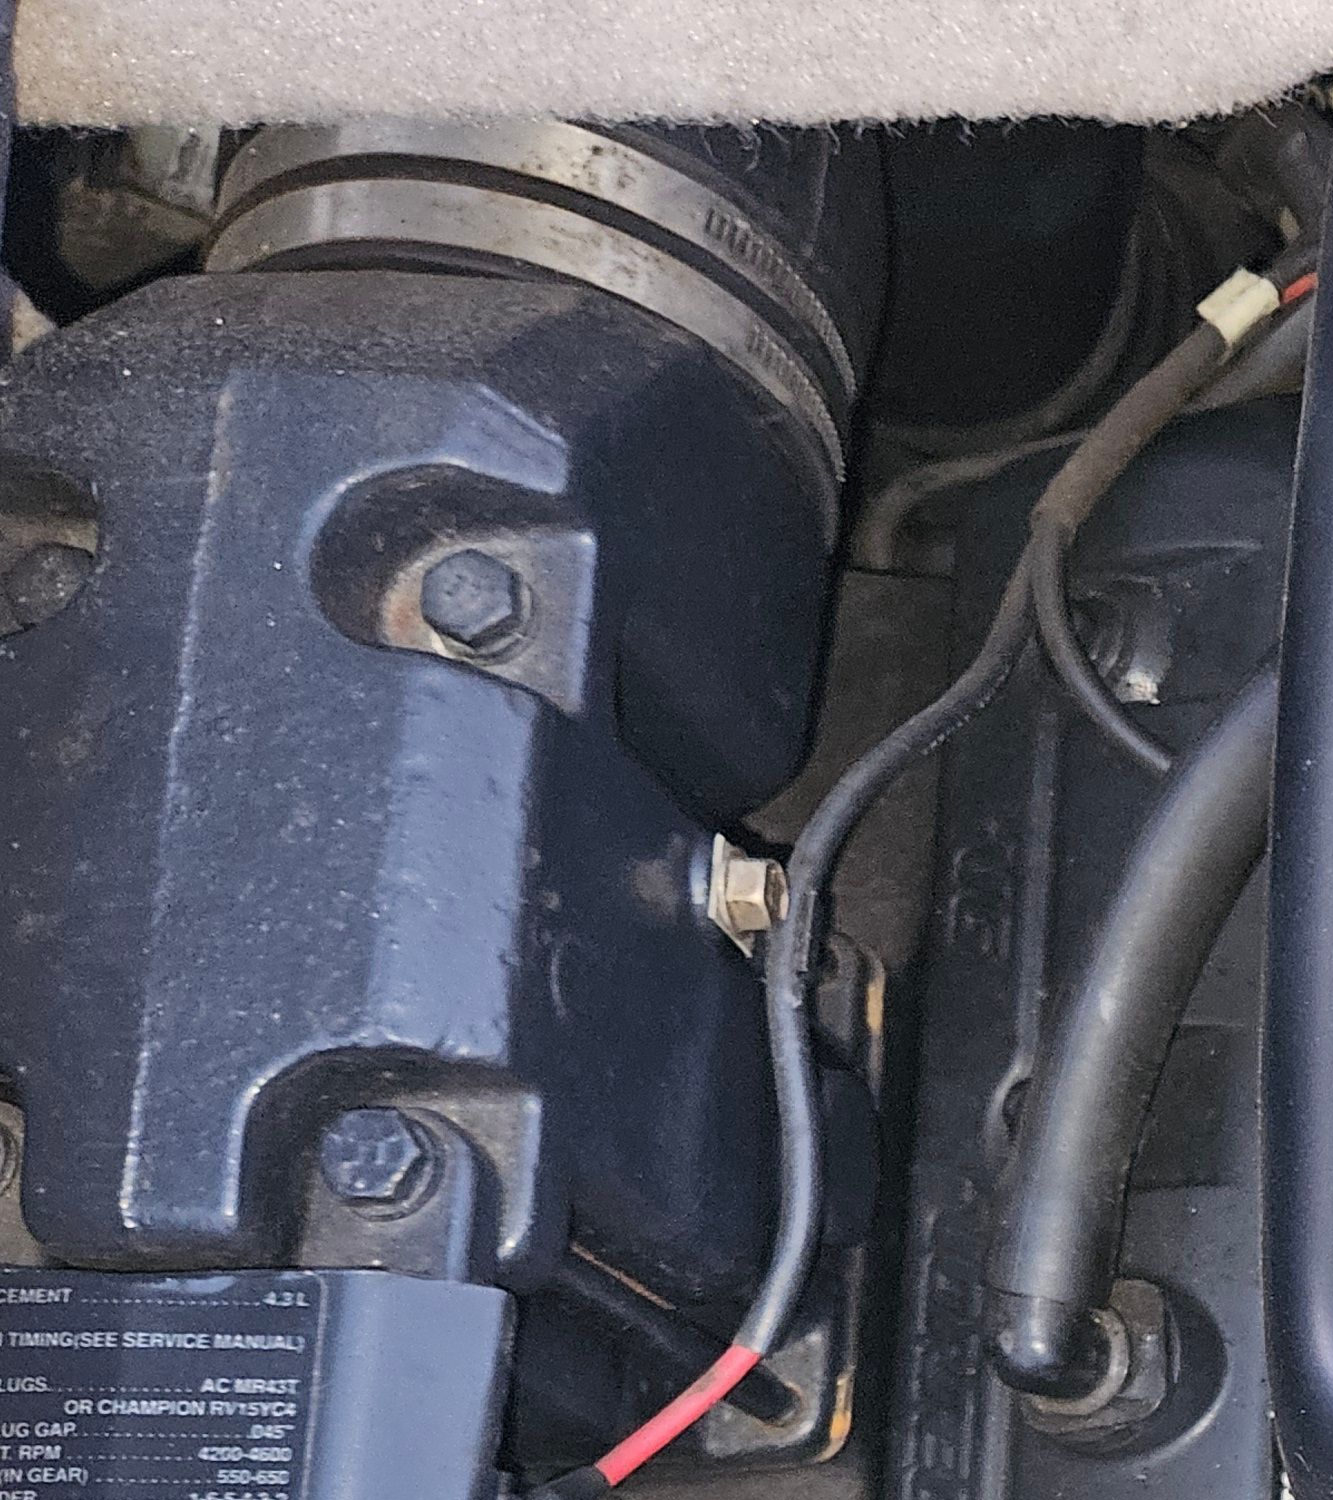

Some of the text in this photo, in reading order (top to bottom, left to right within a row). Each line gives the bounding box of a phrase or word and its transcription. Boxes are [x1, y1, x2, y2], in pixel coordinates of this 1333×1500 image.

[122, 1332, 211, 1348] SERVICE
[213, 1334, 305, 1353] MANUAL)
[201, 1378, 231, 1393] AC
[64, 1399, 93, 1415] OR
[97, 1399, 205, 1416] CHAMPION
[19, 1445, 62, 1460] RPM
[27, 1467, 88, 1486] GEAR)
